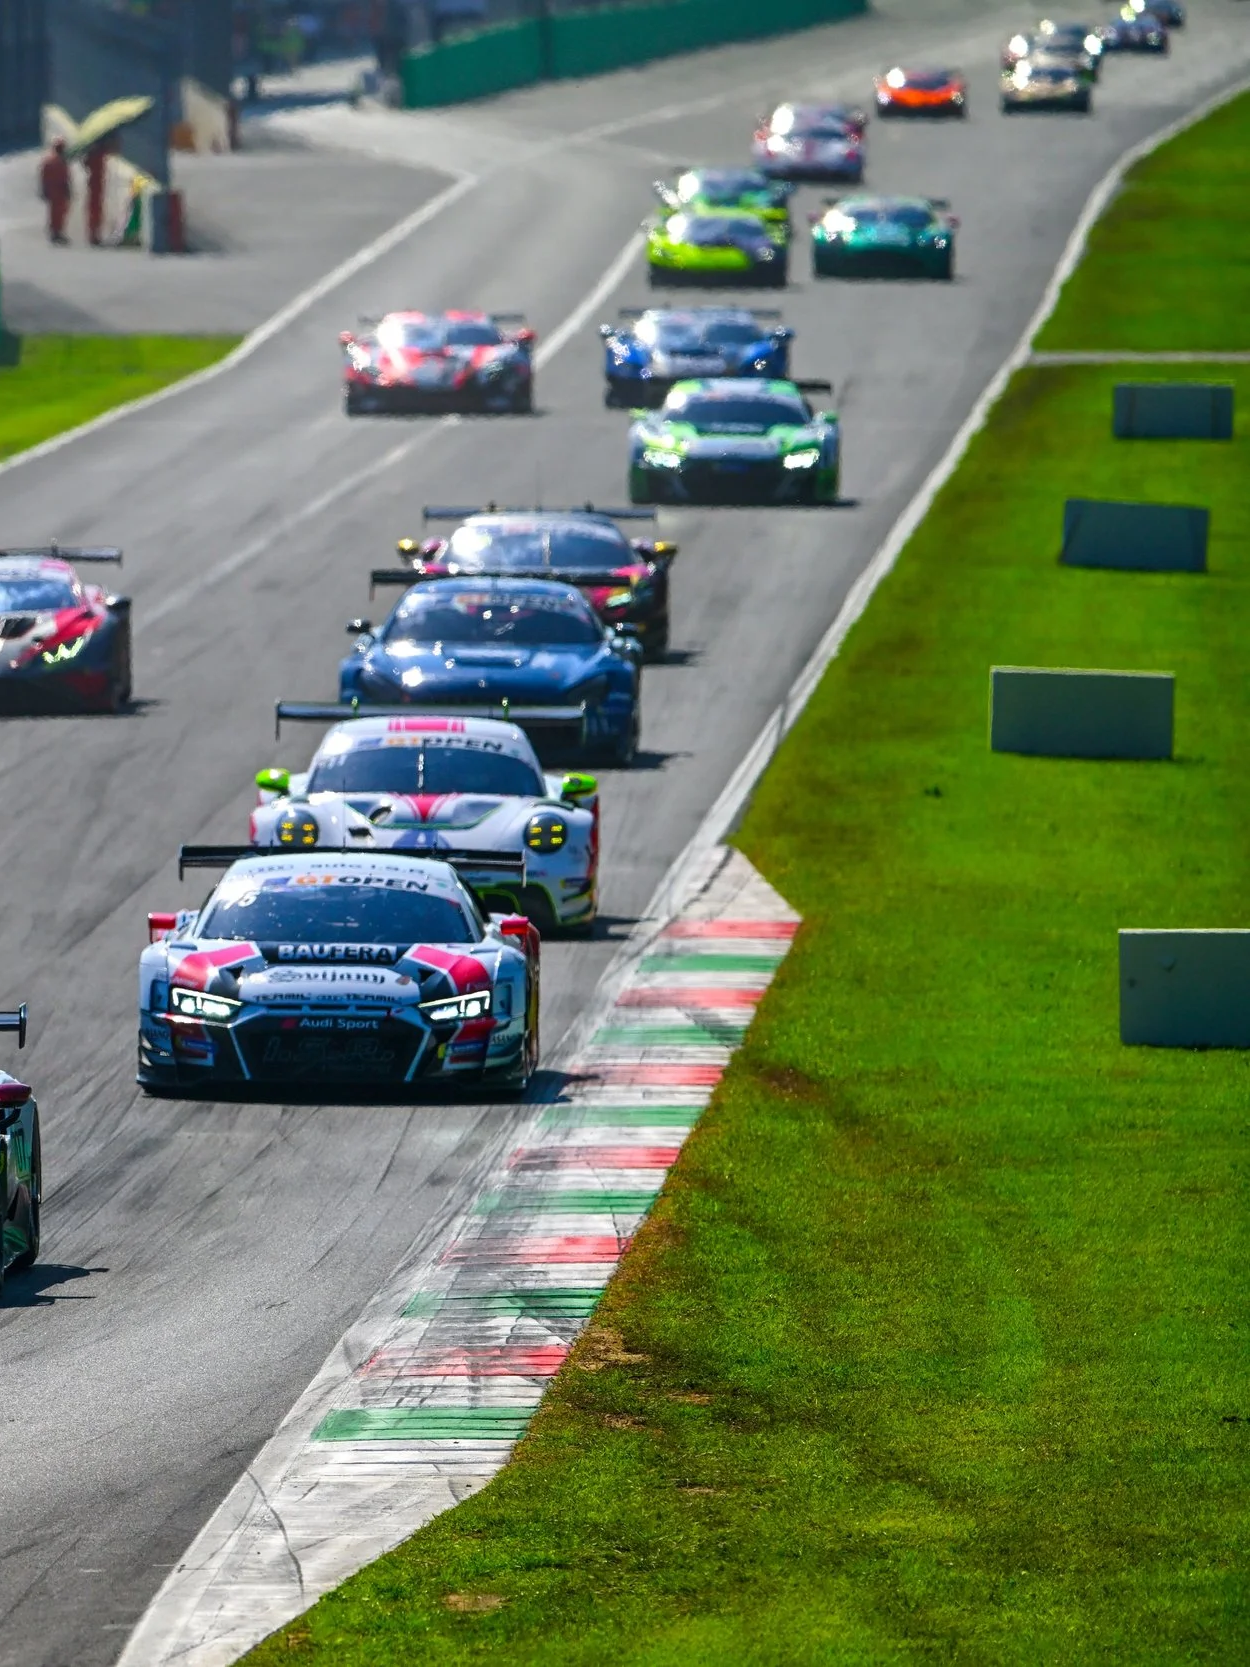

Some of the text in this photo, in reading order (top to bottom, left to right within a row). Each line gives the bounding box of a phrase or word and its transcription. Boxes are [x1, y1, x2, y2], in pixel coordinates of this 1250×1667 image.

[278, 944, 393, 961] BAUFERA
[299, 1018, 379, 1030] Audi Sport
